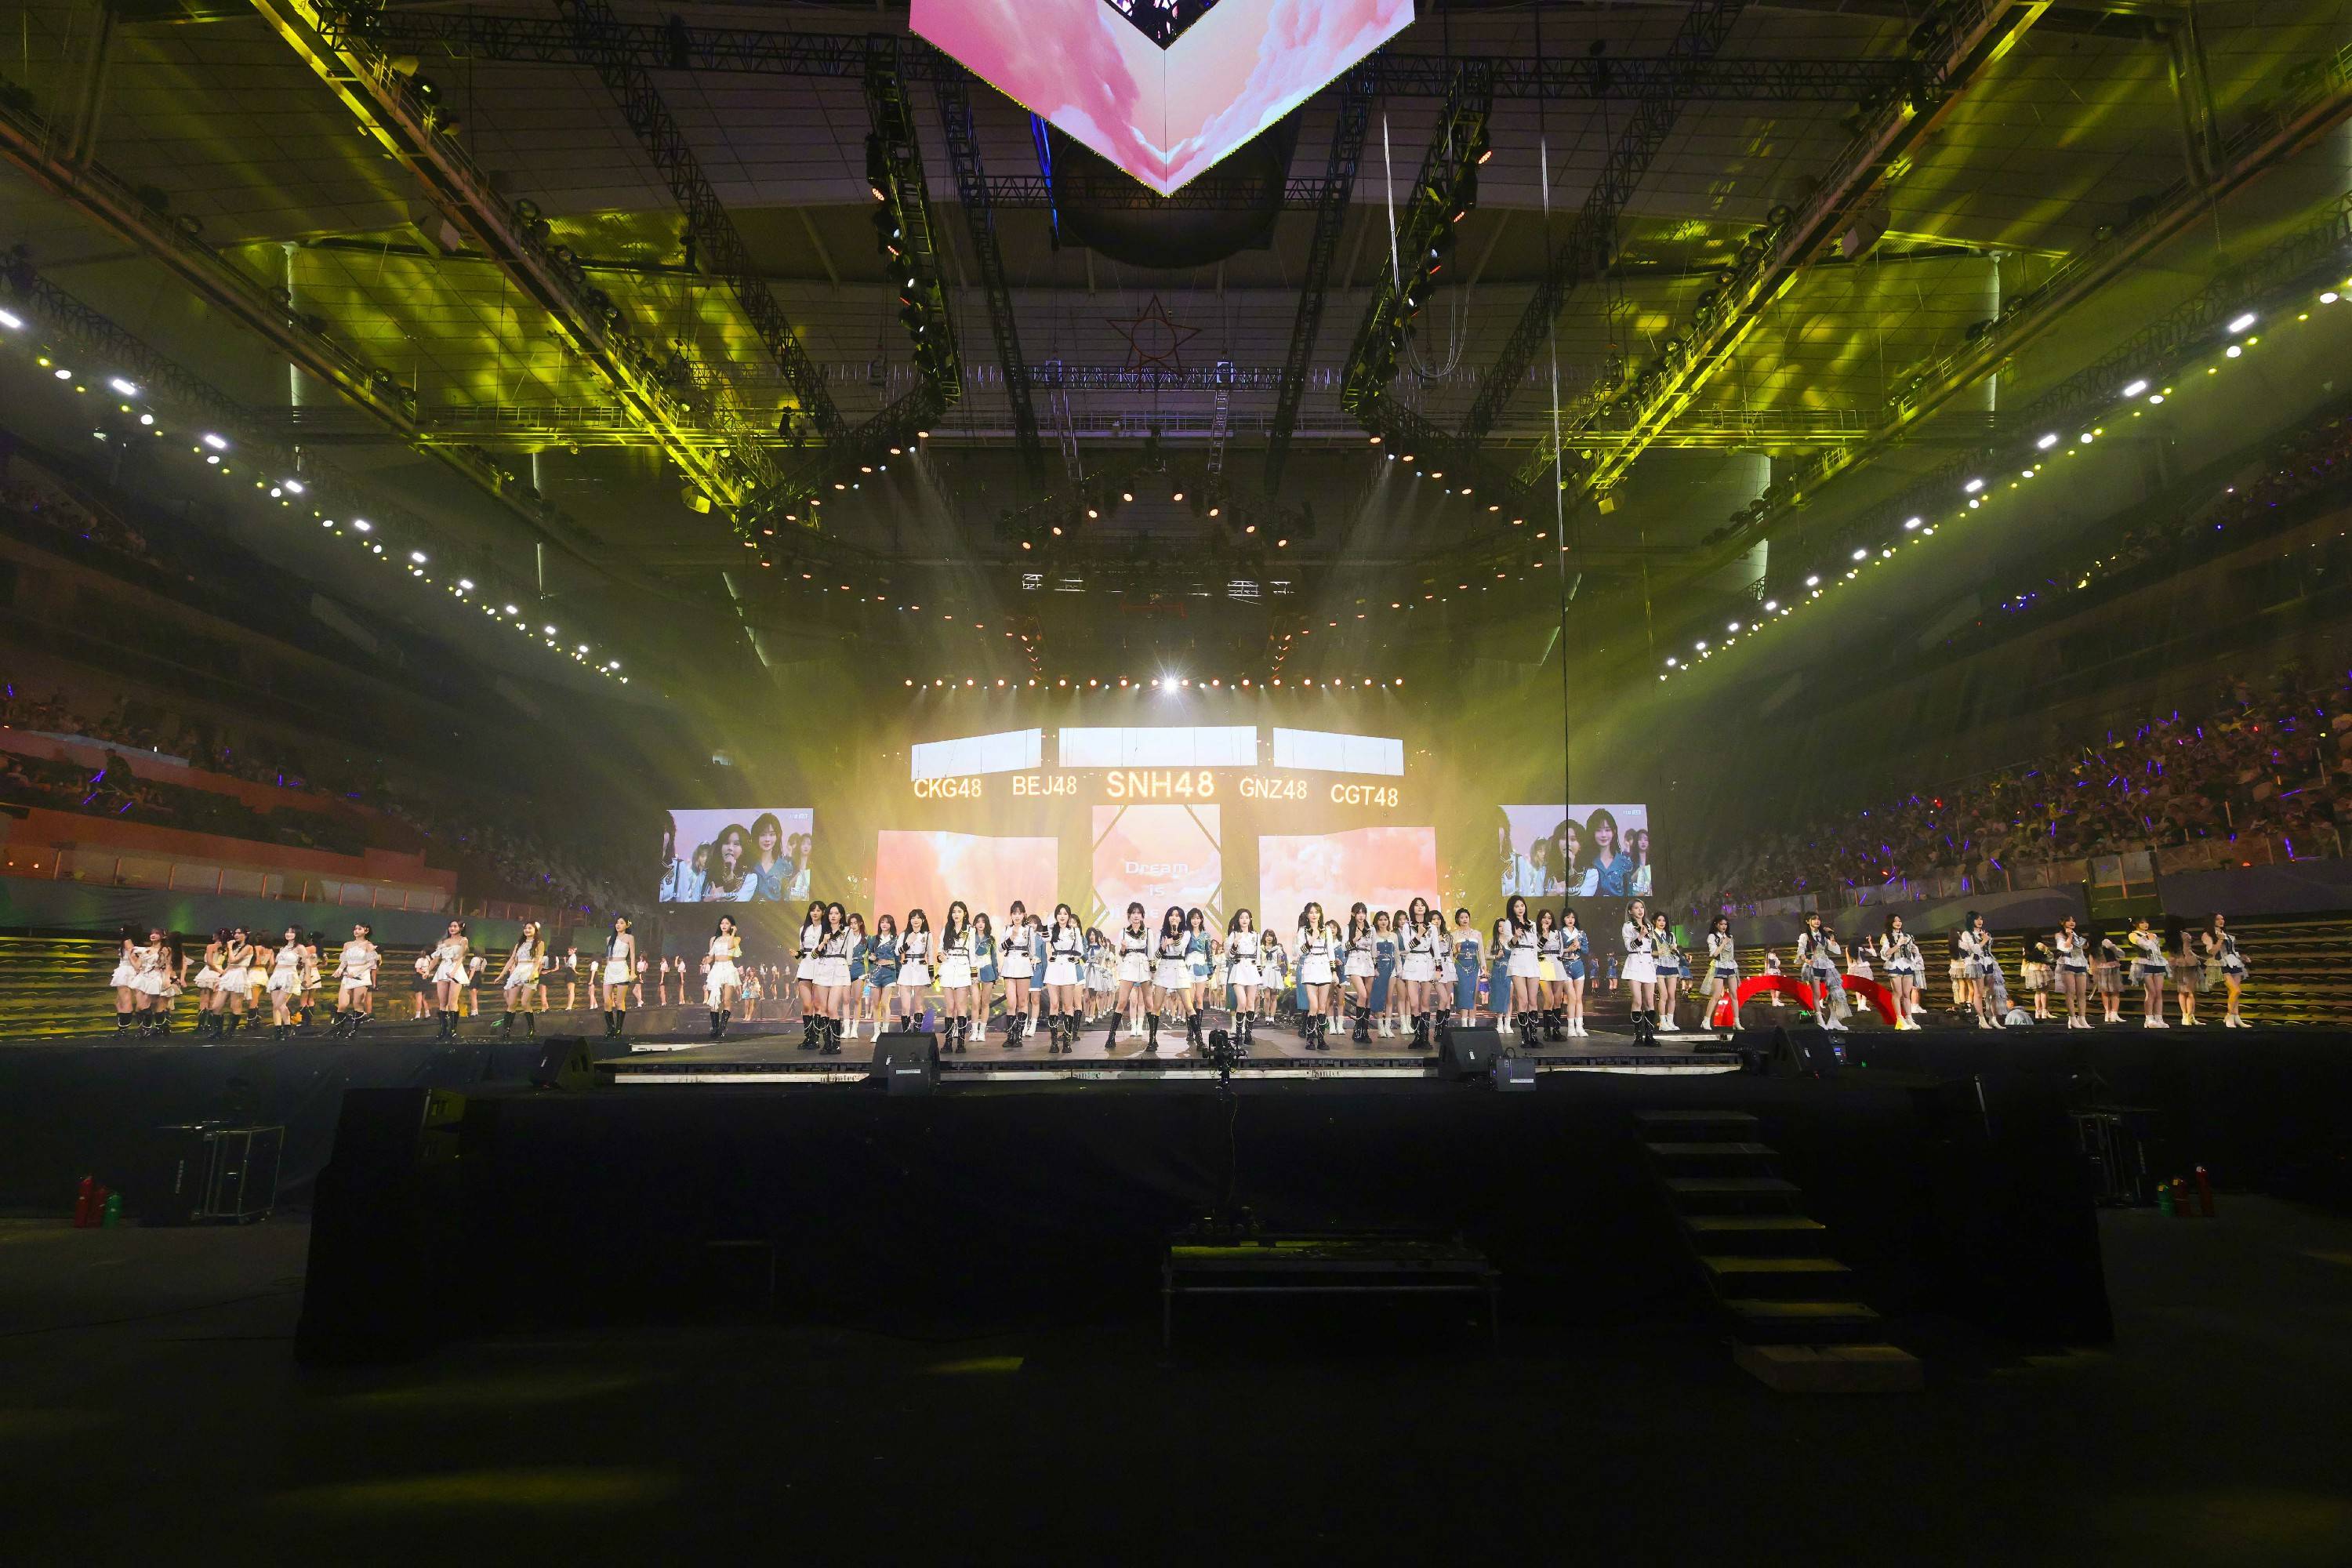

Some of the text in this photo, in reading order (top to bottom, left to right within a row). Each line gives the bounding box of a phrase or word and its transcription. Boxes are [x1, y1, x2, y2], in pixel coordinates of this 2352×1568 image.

[914, 778, 982, 798] CKG48
[1012, 775, 1077, 796] BEJ48
[1106, 771, 1214, 798] SNH48
[1240, 778, 1308, 800] GNZ48
[1330, 783, 1399, 808] CGT48
[1124, 861, 1189, 874] Dream
